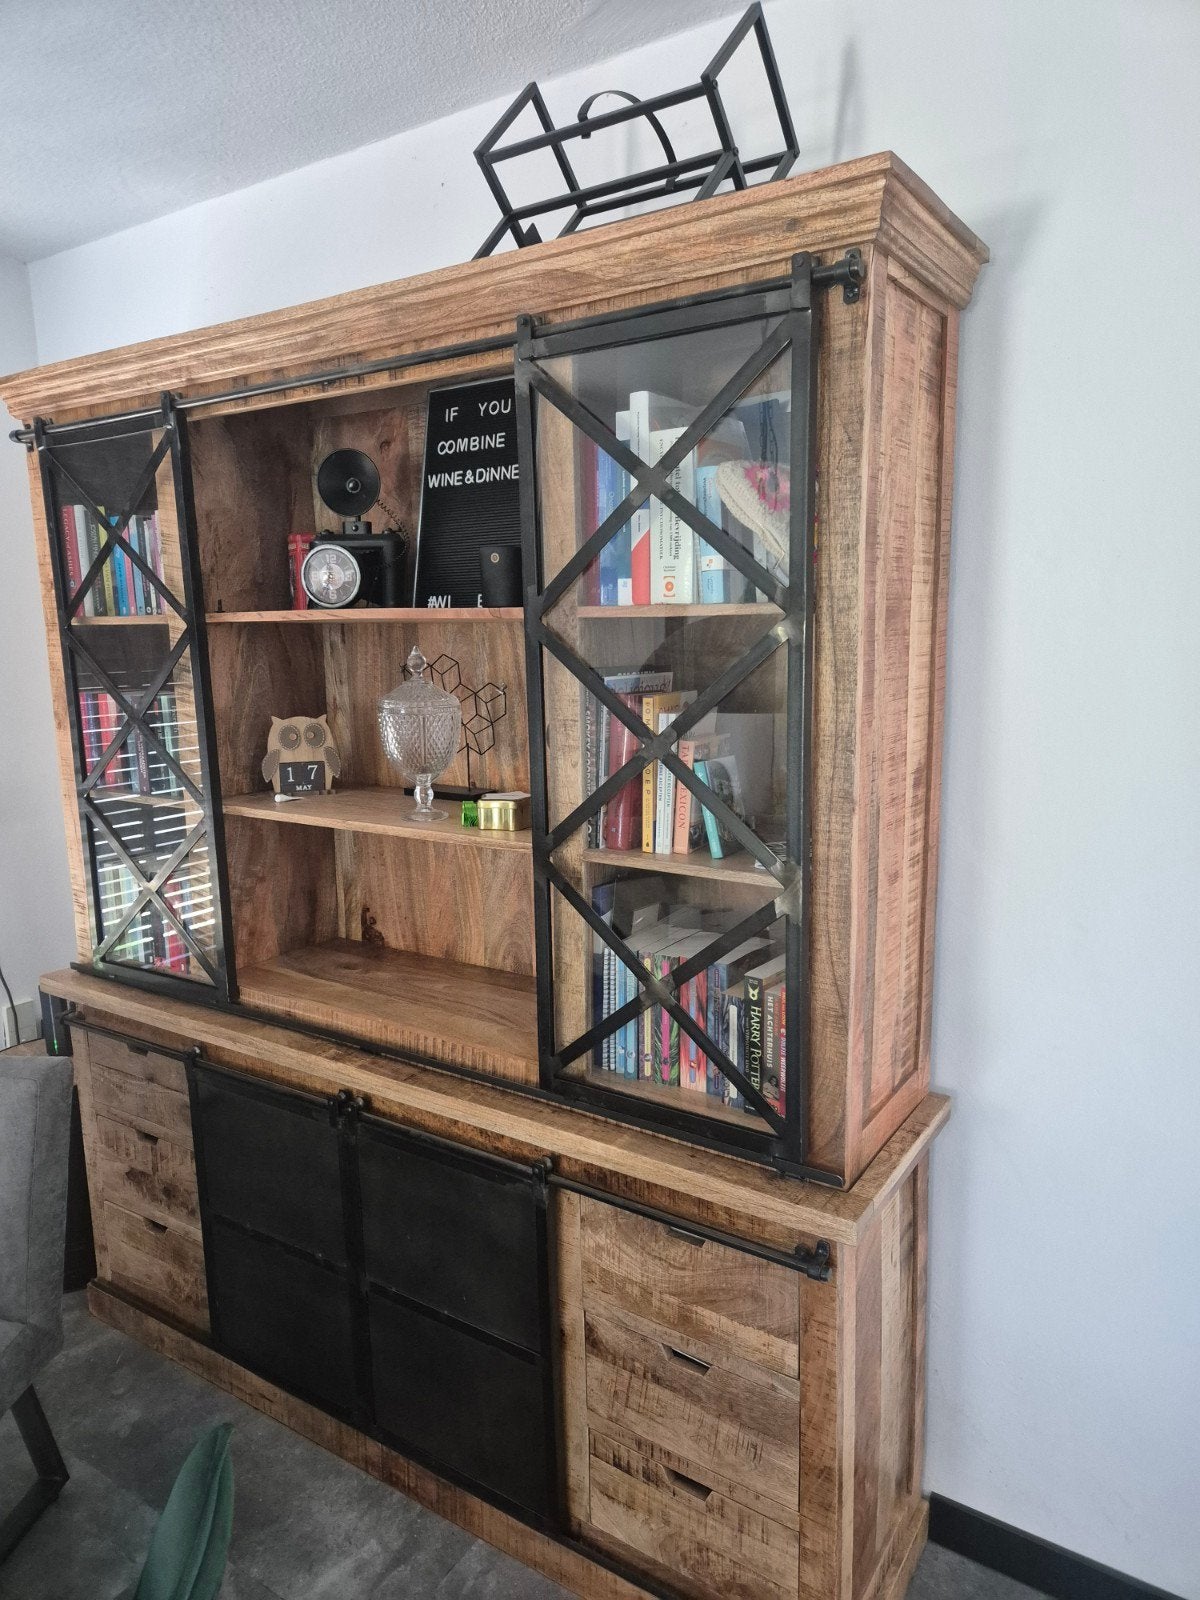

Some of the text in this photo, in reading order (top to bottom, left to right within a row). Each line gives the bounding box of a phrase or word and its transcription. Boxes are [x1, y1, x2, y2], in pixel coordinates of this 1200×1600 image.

[445, 398, 512, 422] IF YOU
[437, 432, 506, 455] COMBINE
[678, 786, 688, 829] EXICON
[750, 1005, 762, 1090] HARRY POTTER
[766, 1014, 774, 1068] ACHTERHUIS
